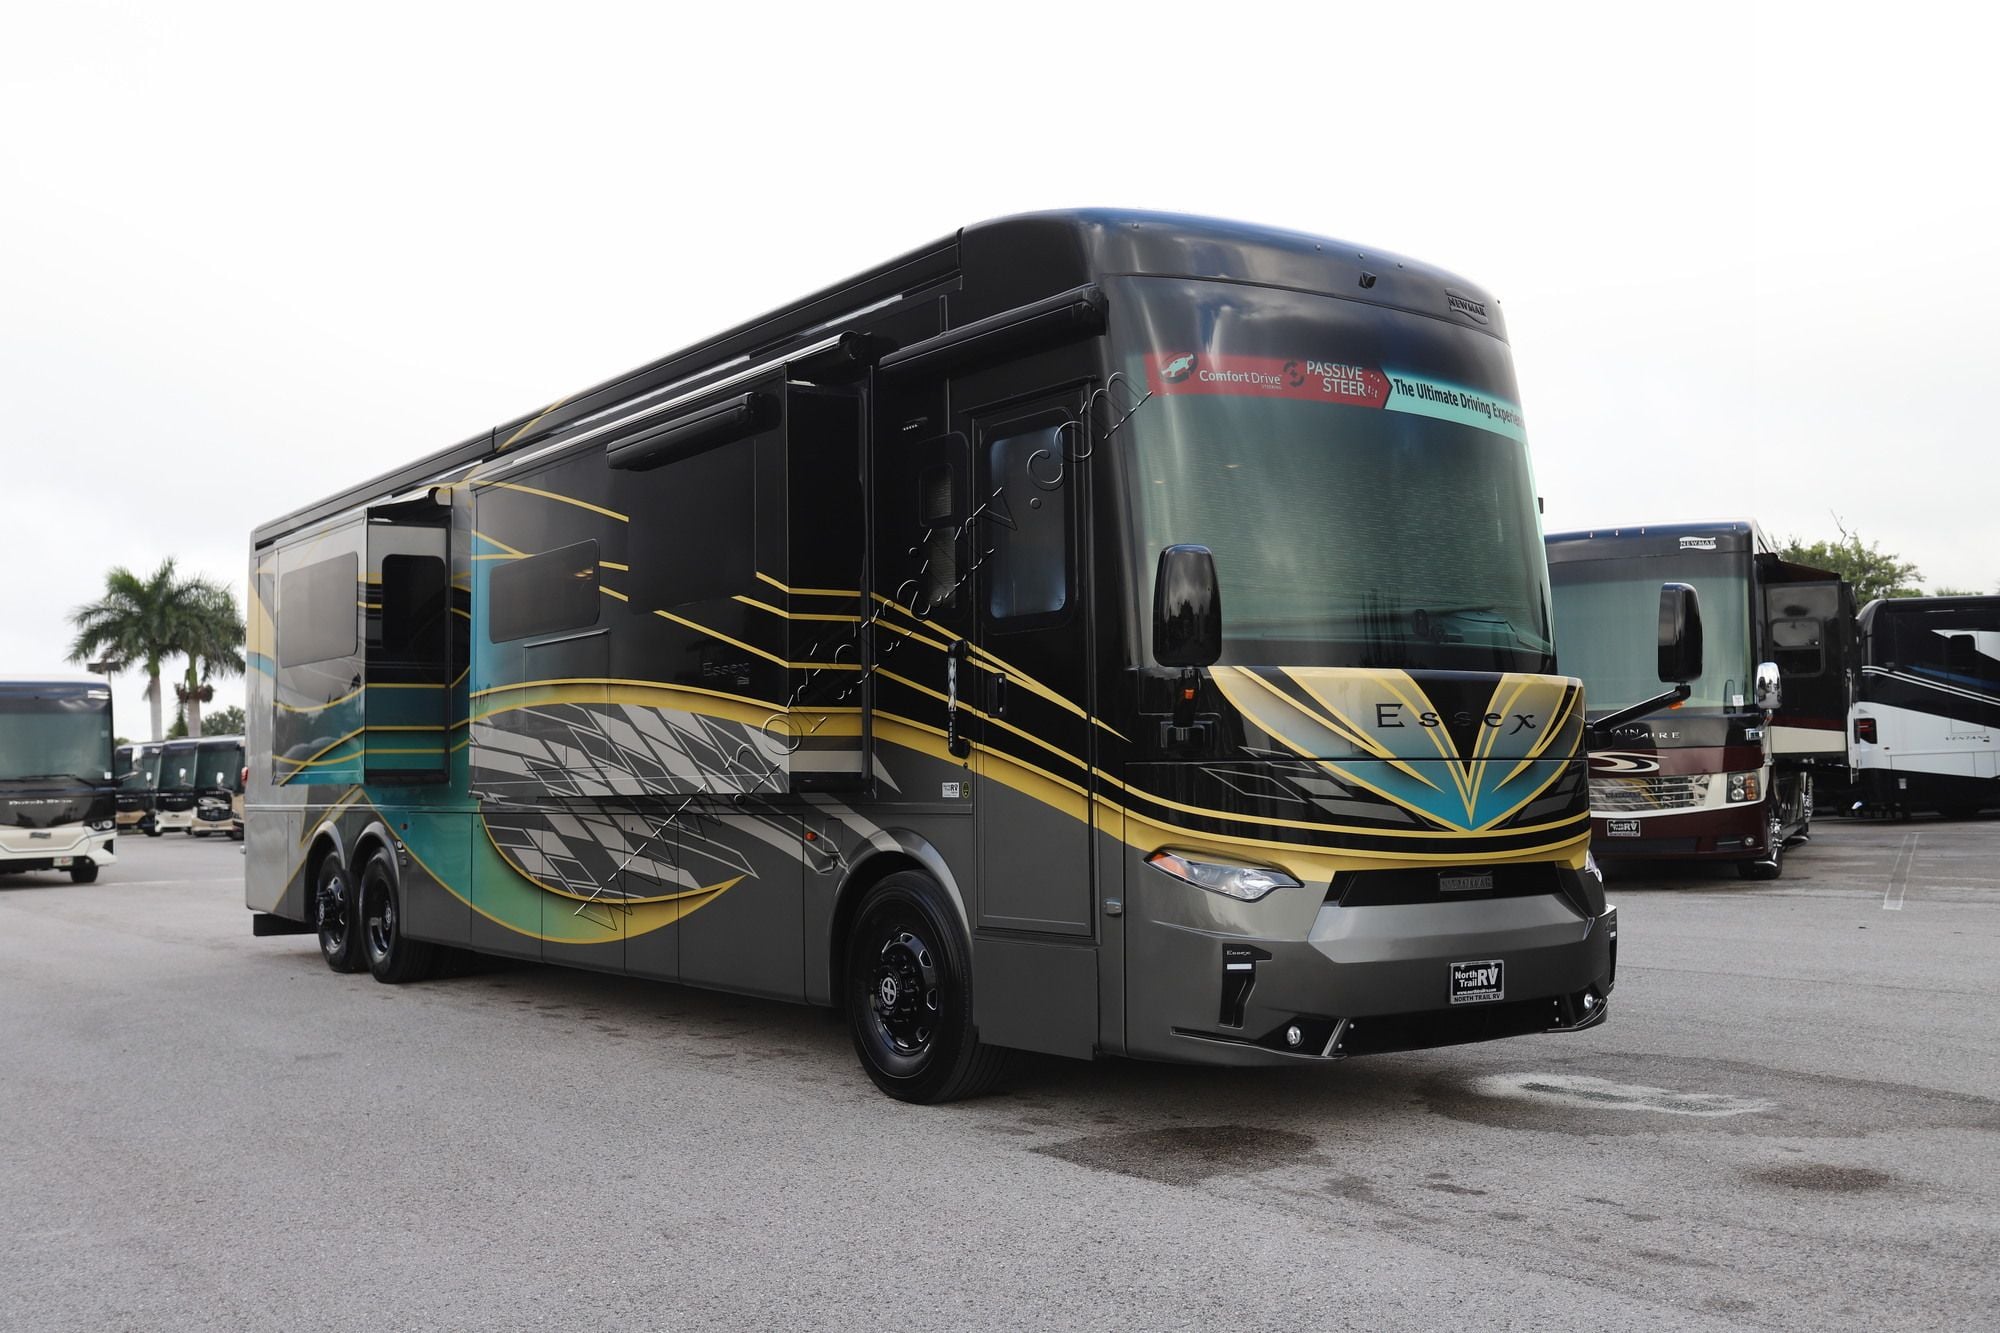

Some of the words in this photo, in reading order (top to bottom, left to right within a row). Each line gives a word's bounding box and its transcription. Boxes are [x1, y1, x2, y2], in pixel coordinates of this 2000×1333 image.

[1447, 296, 1487, 317] NEWMAR
[1199, 369, 1250, 383] Comfort
[1250, 371, 1281, 385] Drive
[1306, 360, 1363, 381] PASSIVE
[1322, 377, 1366, 397] STEER
[1393, 378, 1414, 397] The
[1416, 382, 1459, 406] Ultimate
[1460, 393, 1491, 419] Driving
[1680, 539, 1715, 547] NEWMAR
[703, 662, 750, 676] Essex
[1376, 703, 1537, 735] Essex
[1633, 732, 1680, 740] AIRE
[1623, 822, 1638, 831] RV
[1455, 970, 1478, 980] North
[1477, 967, 1499, 987] RV
[1459, 978, 1478, 988] Trail
[1475, 993, 1491, 1001] TRAIL
